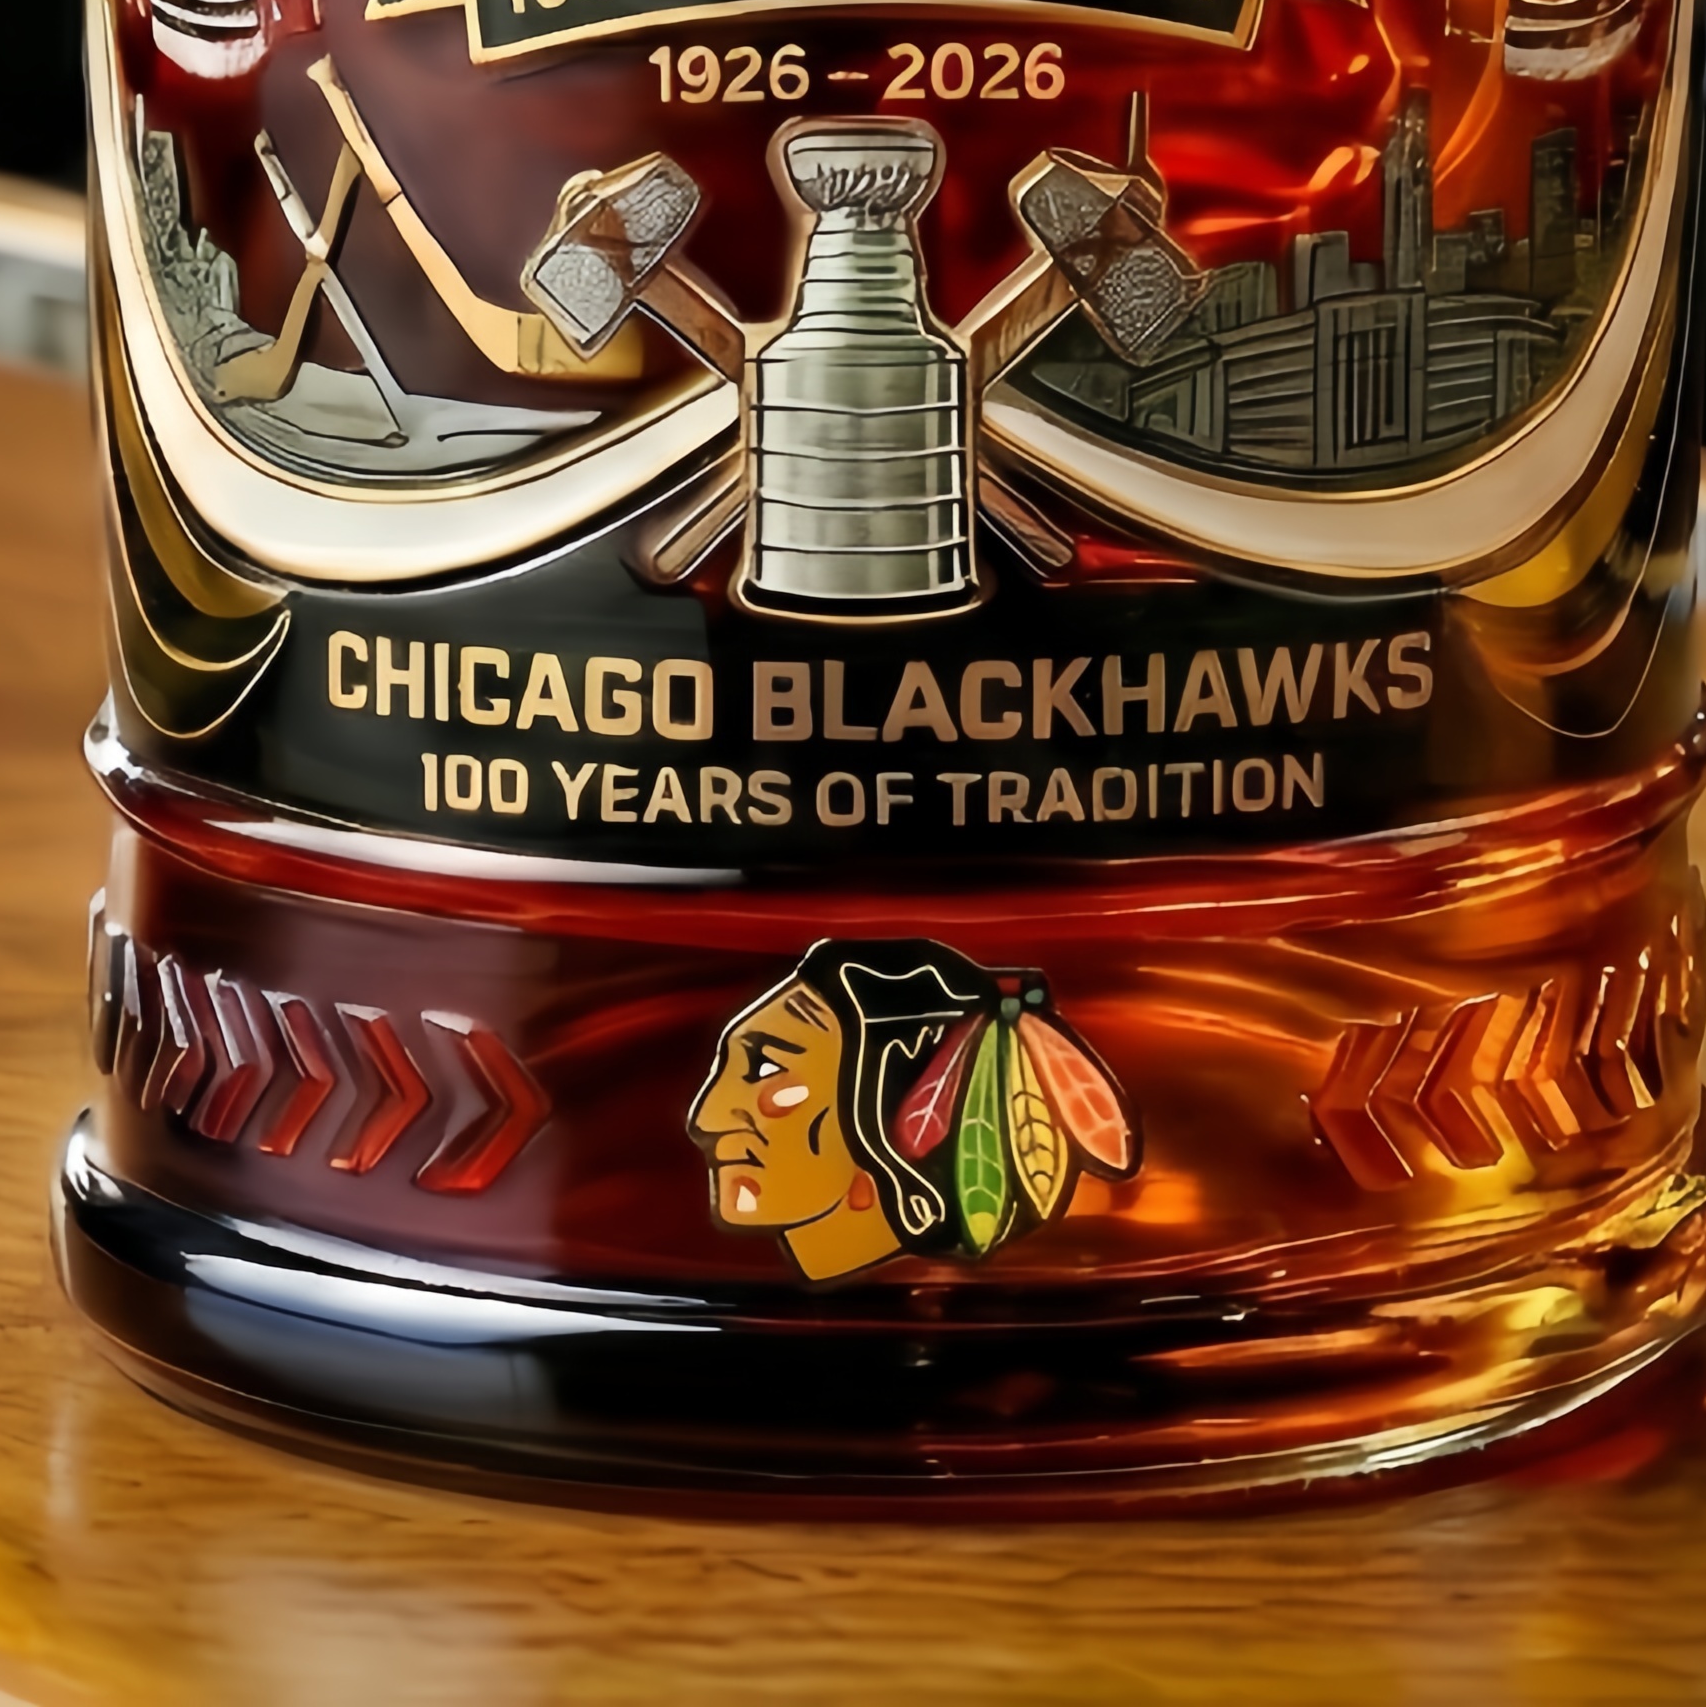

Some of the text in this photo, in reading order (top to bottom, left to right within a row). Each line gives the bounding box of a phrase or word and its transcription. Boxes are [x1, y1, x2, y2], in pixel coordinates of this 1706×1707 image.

[648, 43, 810, 104] 1926
[884, 42, 1066, 101] 2026
[327, 629, 1435, 743] CHICAGO BLACKHAWKS
[421, 751, 1325, 827] 100 YEARS OF TRADITION
